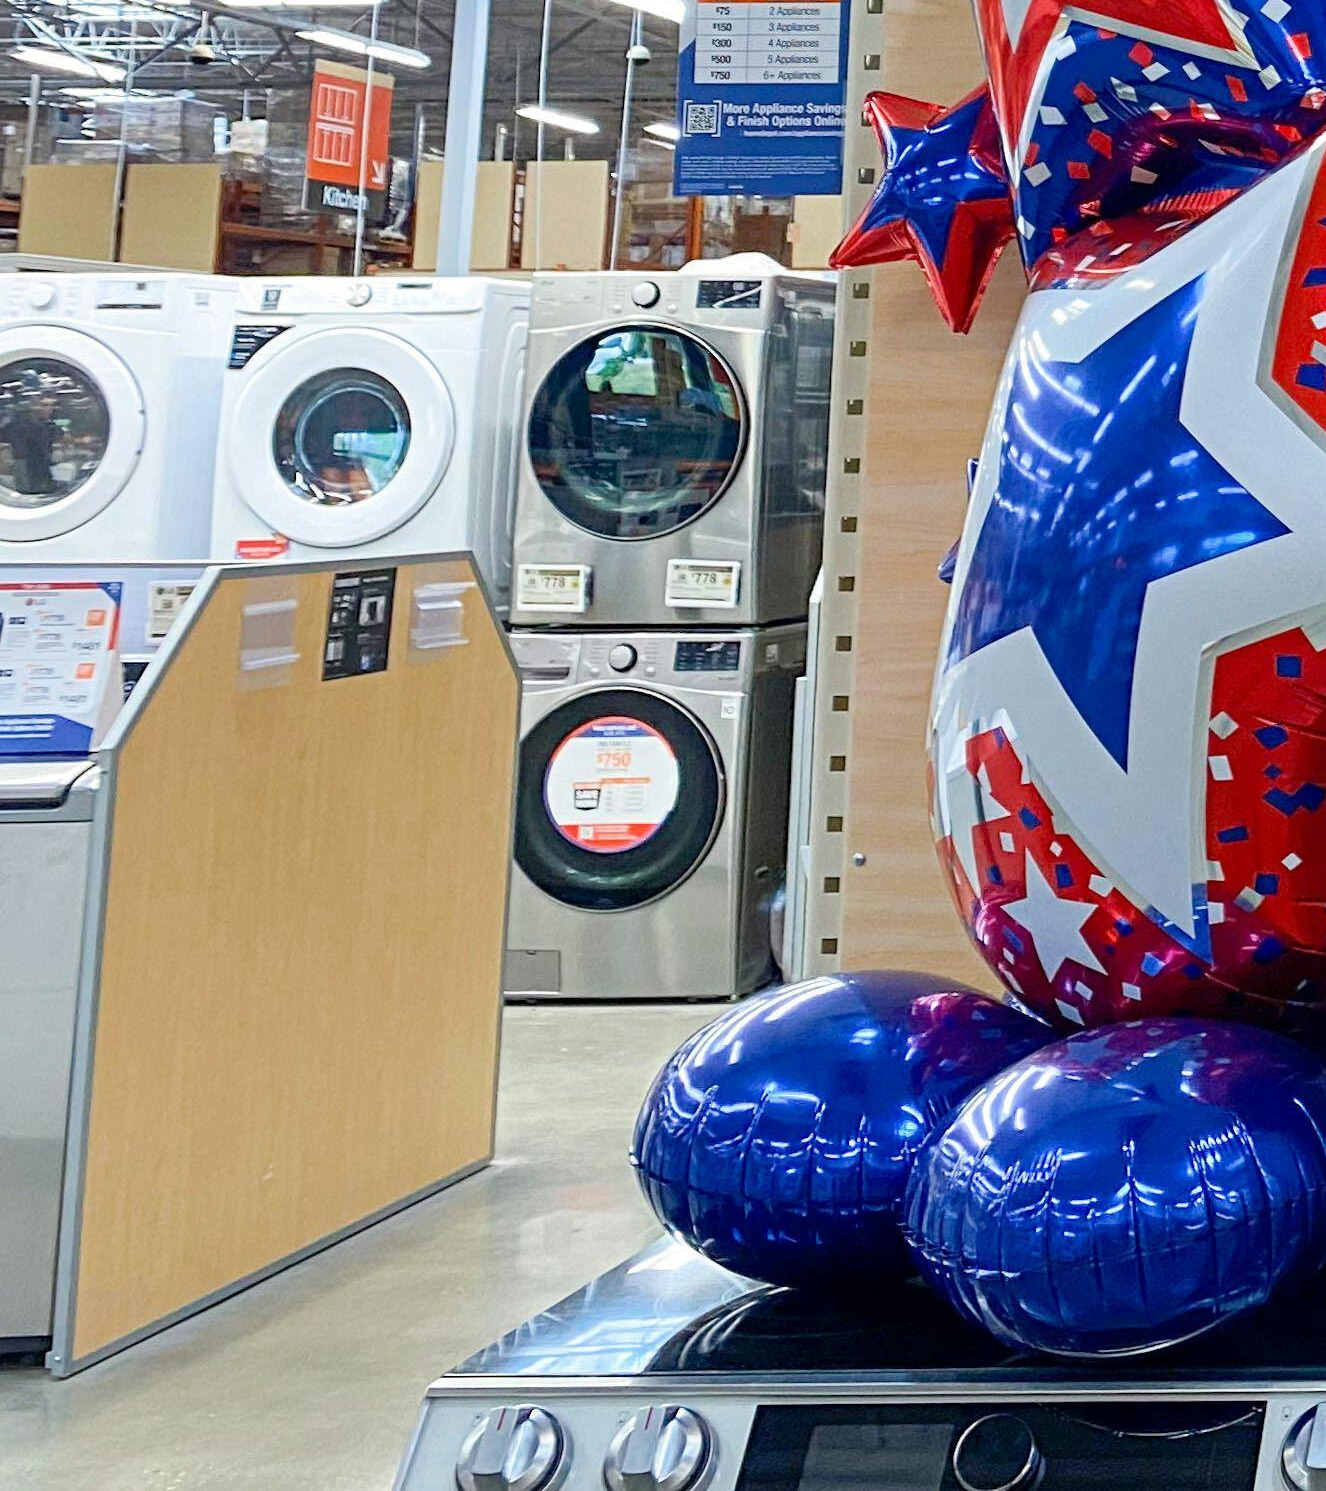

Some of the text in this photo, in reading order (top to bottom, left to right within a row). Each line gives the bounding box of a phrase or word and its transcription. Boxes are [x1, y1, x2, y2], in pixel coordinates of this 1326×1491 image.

[776, 7, 820, 16] Appliances
[776, 23, 819, 33] Appliances
[775, 39, 819, 49] Appliances
[775, 55, 818, 65] Appliances
[777, 71, 821, 81] Appliances
[723, 103, 750, 114] More
[752, 102, 804, 116] Appliance
[726, 116, 735, 126] &
[738, 116, 769, 126] Finish
[772, 115, 811, 128] Options
